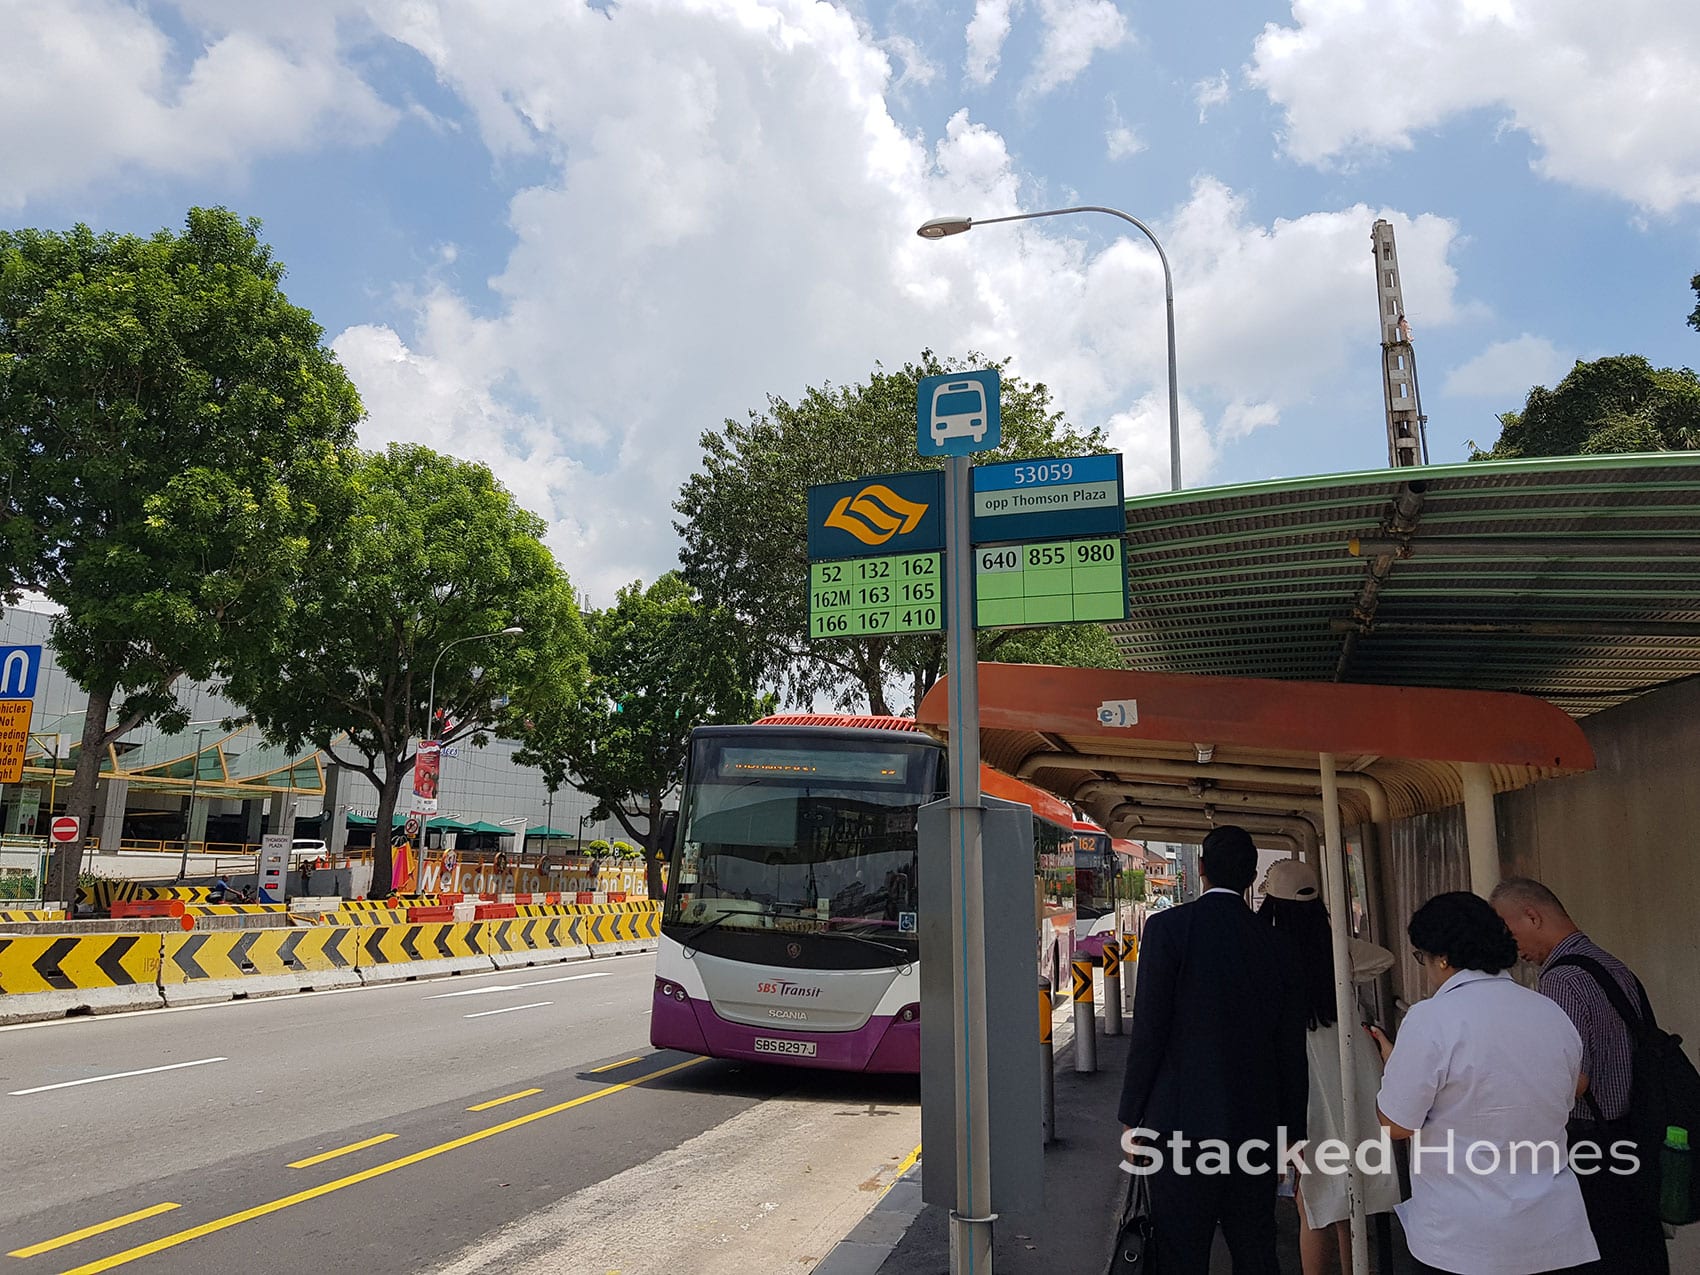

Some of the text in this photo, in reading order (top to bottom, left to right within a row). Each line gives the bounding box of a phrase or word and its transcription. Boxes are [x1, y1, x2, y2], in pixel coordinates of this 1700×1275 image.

[1014, 463, 1073, 485] 53059
[985, 489, 1107, 511] opp Thomson Plaza
[982, 544, 1115, 570] 640 855 980
[821, 558, 934, 583] 52 132 162
[813, 583, 935, 608] 162M 163 165
[816, 608, 936, 632] 166 167 410
[0, 703, 27, 714] hicles
[1079, 837, 1097, 851] 162
[522, 871, 540, 894] to
[548, 871, 618, 893] Thomson
[757, 981, 824, 997] SBS Transit
[768, 1009, 808, 1020] SCANIA
[756, 1039, 816, 1055] SBS8297J
